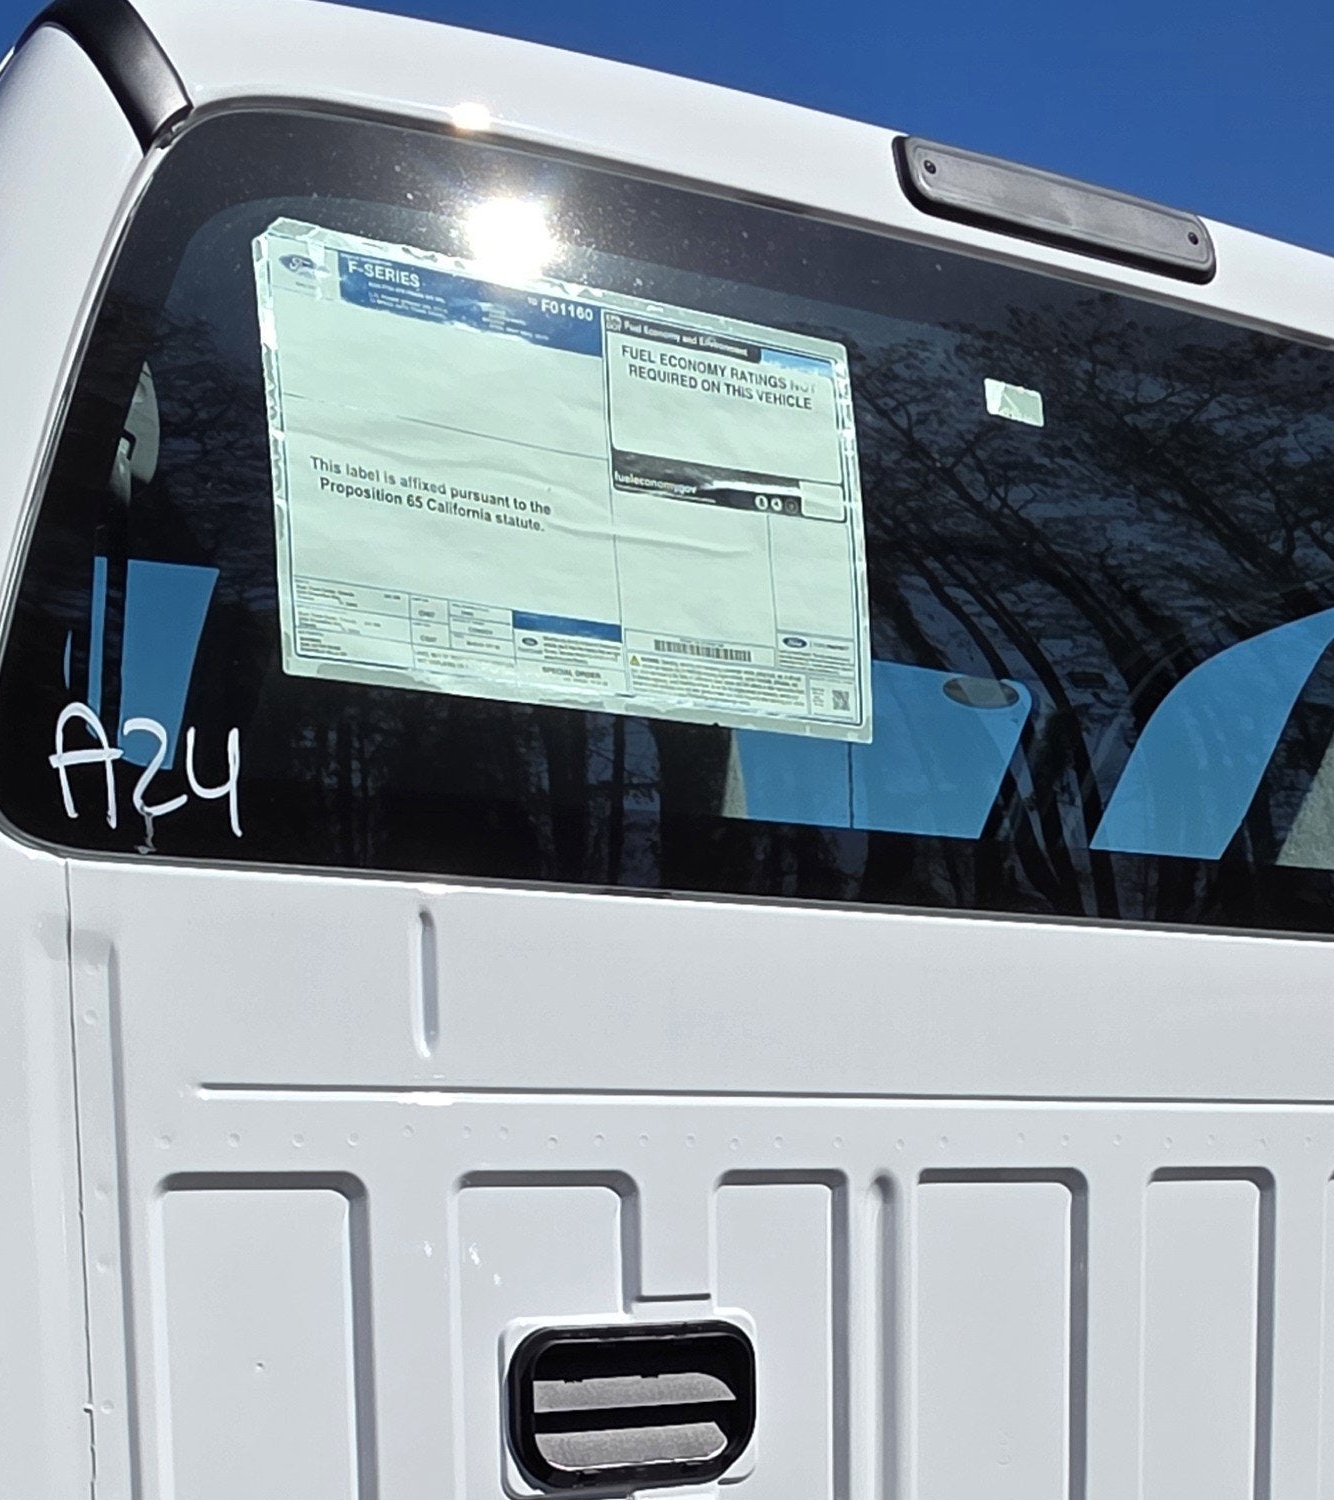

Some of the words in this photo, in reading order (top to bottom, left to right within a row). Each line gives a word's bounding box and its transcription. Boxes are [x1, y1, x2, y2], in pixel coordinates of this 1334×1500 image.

[348, 260, 421, 287] F-SERIES
[541, 299, 594, 322] F01160
[622, 344, 655, 364] FUEL
[660, 353, 727, 377] ECONOMY
[730, 367, 787, 391] RATINGS
[629, 363, 698, 389] REQUIRED
[701, 378, 721, 394] ON
[726, 382, 754, 400] THIS
[757, 389, 813, 410] VEHICLE
[310, 455, 341, 475] This
[345, 462, 380, 482] label
[383, 472, 397, 486] is
[399, 475, 447, 496] affixed
[449, 485, 510, 508] pursuant
[513, 496, 527, 512] to
[530, 500, 552, 516] the
[319, 476, 403, 506] Proposition
[406, 493, 424, 509] 65
[426, 497, 492, 523] California
[495, 512, 546, 532] statute.
[49, 702, 242, 838] A24
